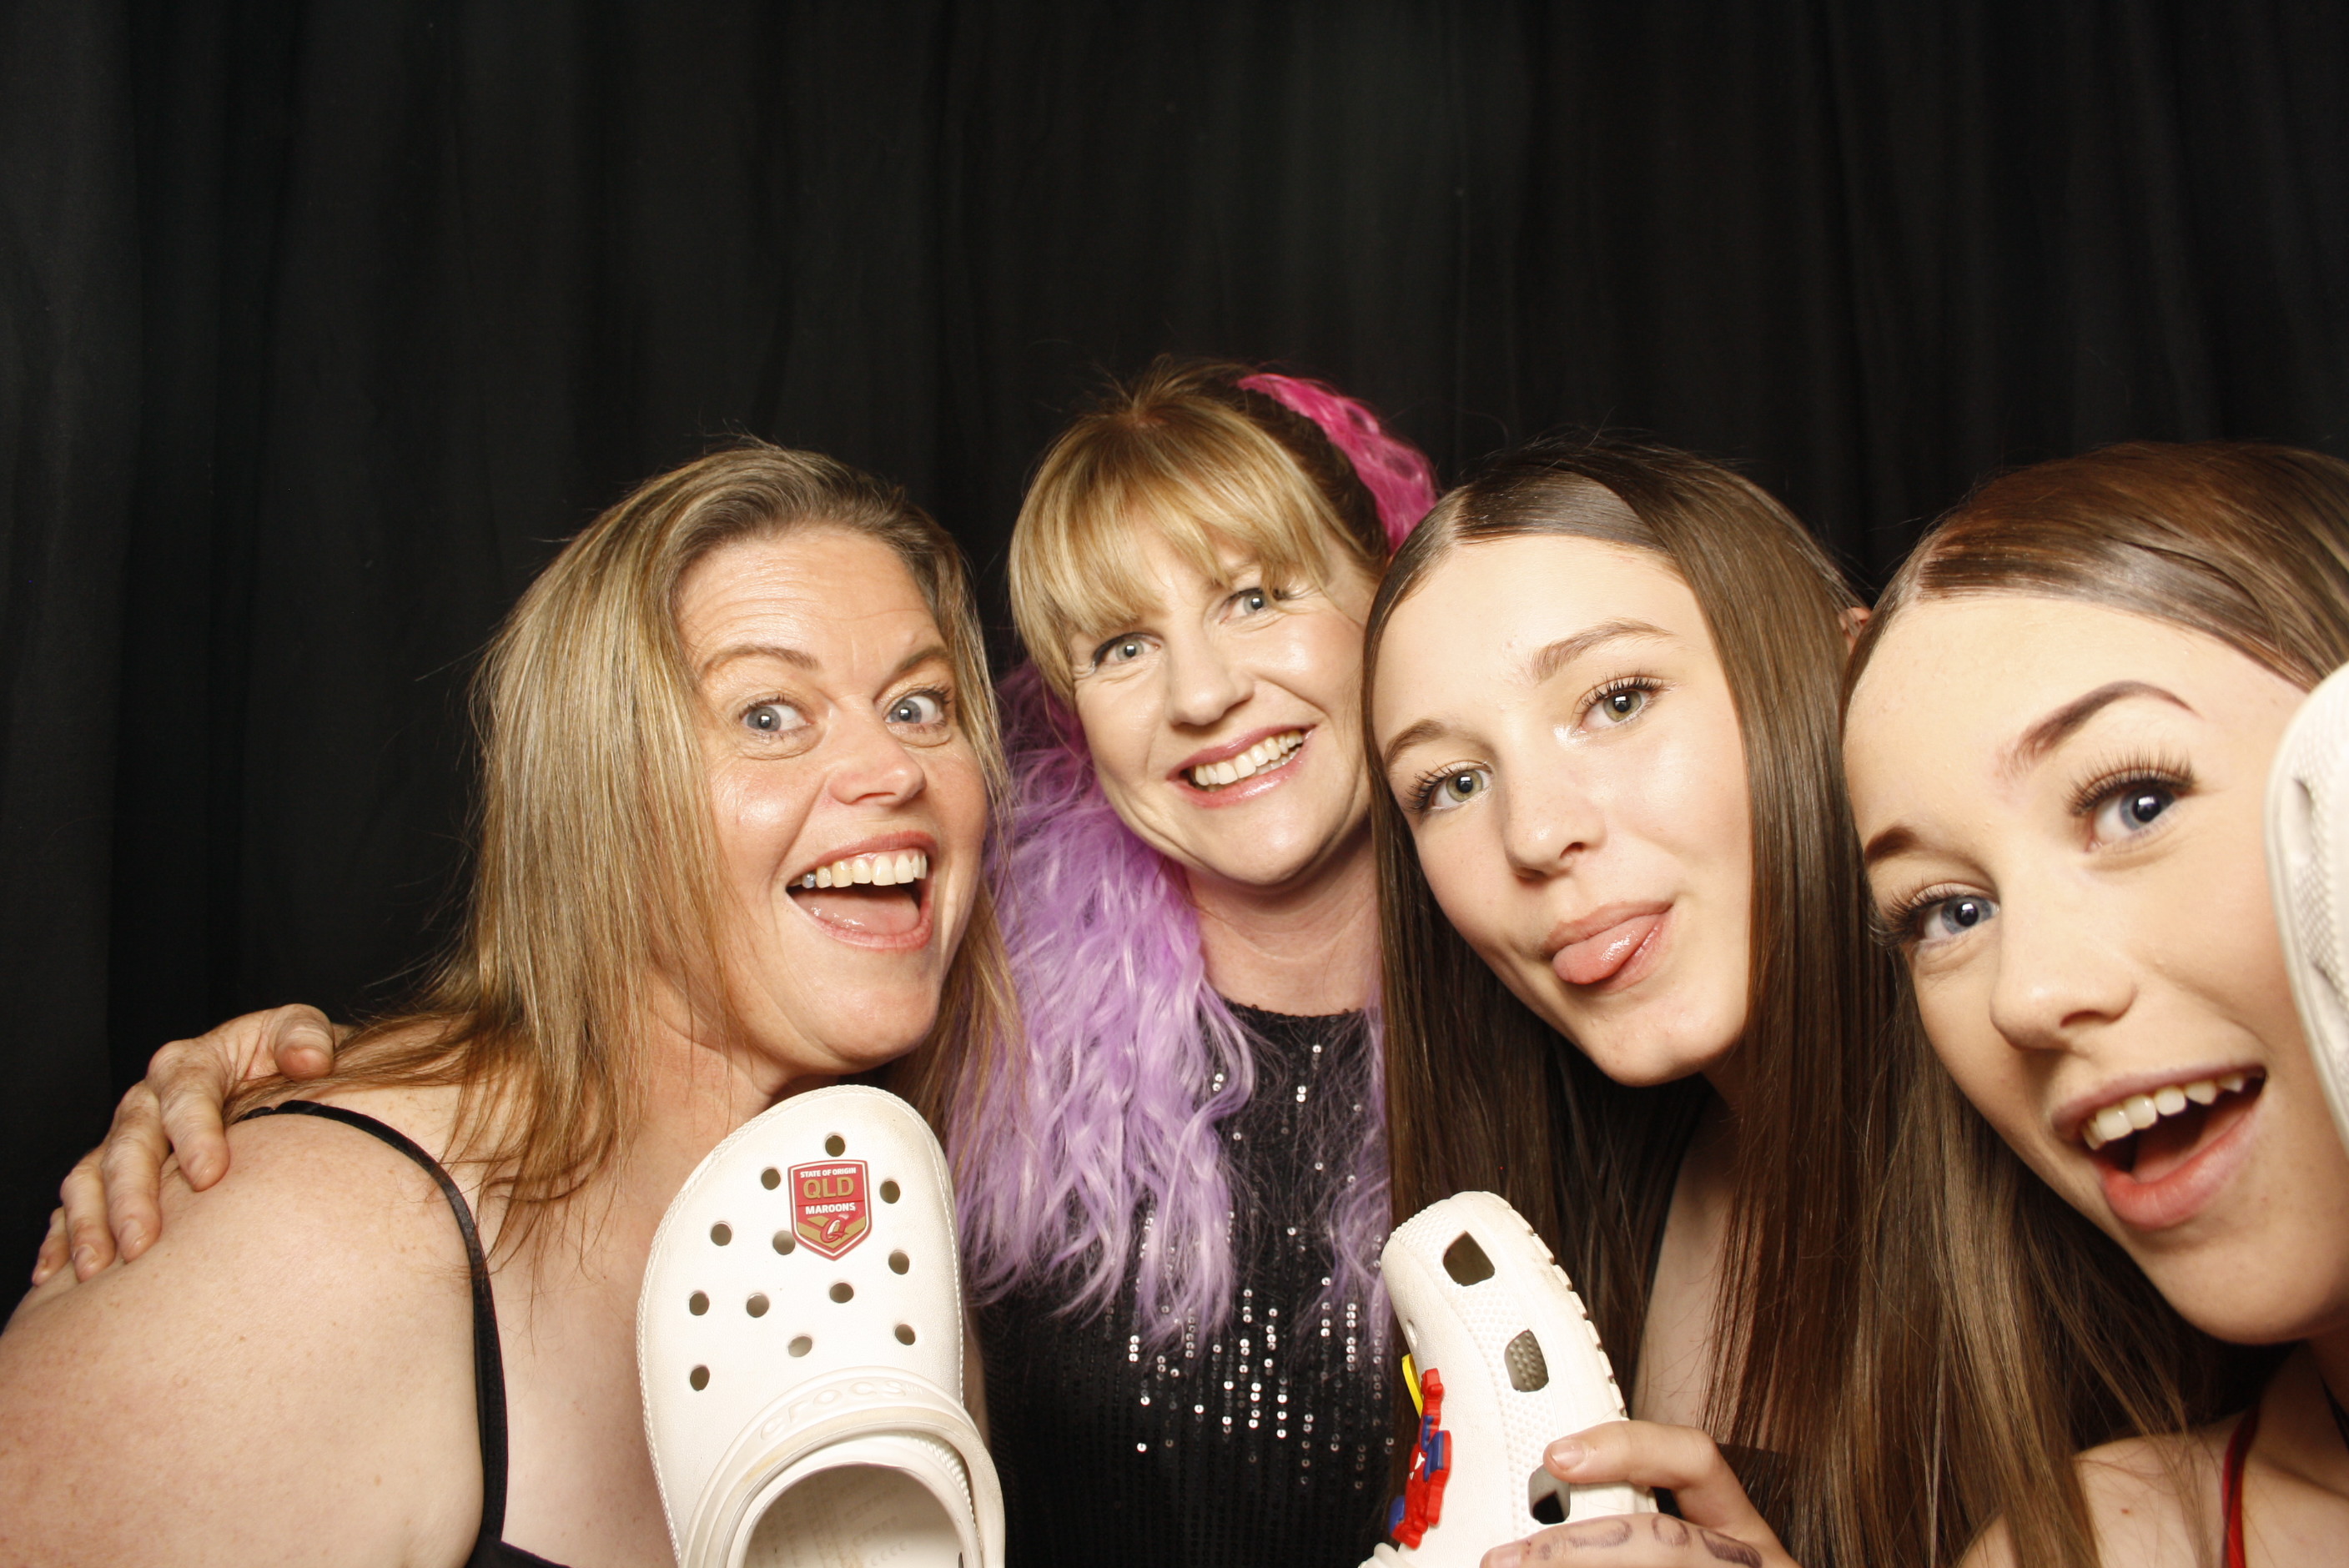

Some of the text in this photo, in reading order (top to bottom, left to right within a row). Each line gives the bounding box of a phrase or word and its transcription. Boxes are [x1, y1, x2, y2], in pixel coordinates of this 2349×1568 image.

[803, 1177, 854, 1199] QLD
[805, 1203, 856, 1214] MAROONS
[760, 1380, 907, 1440] crocs
